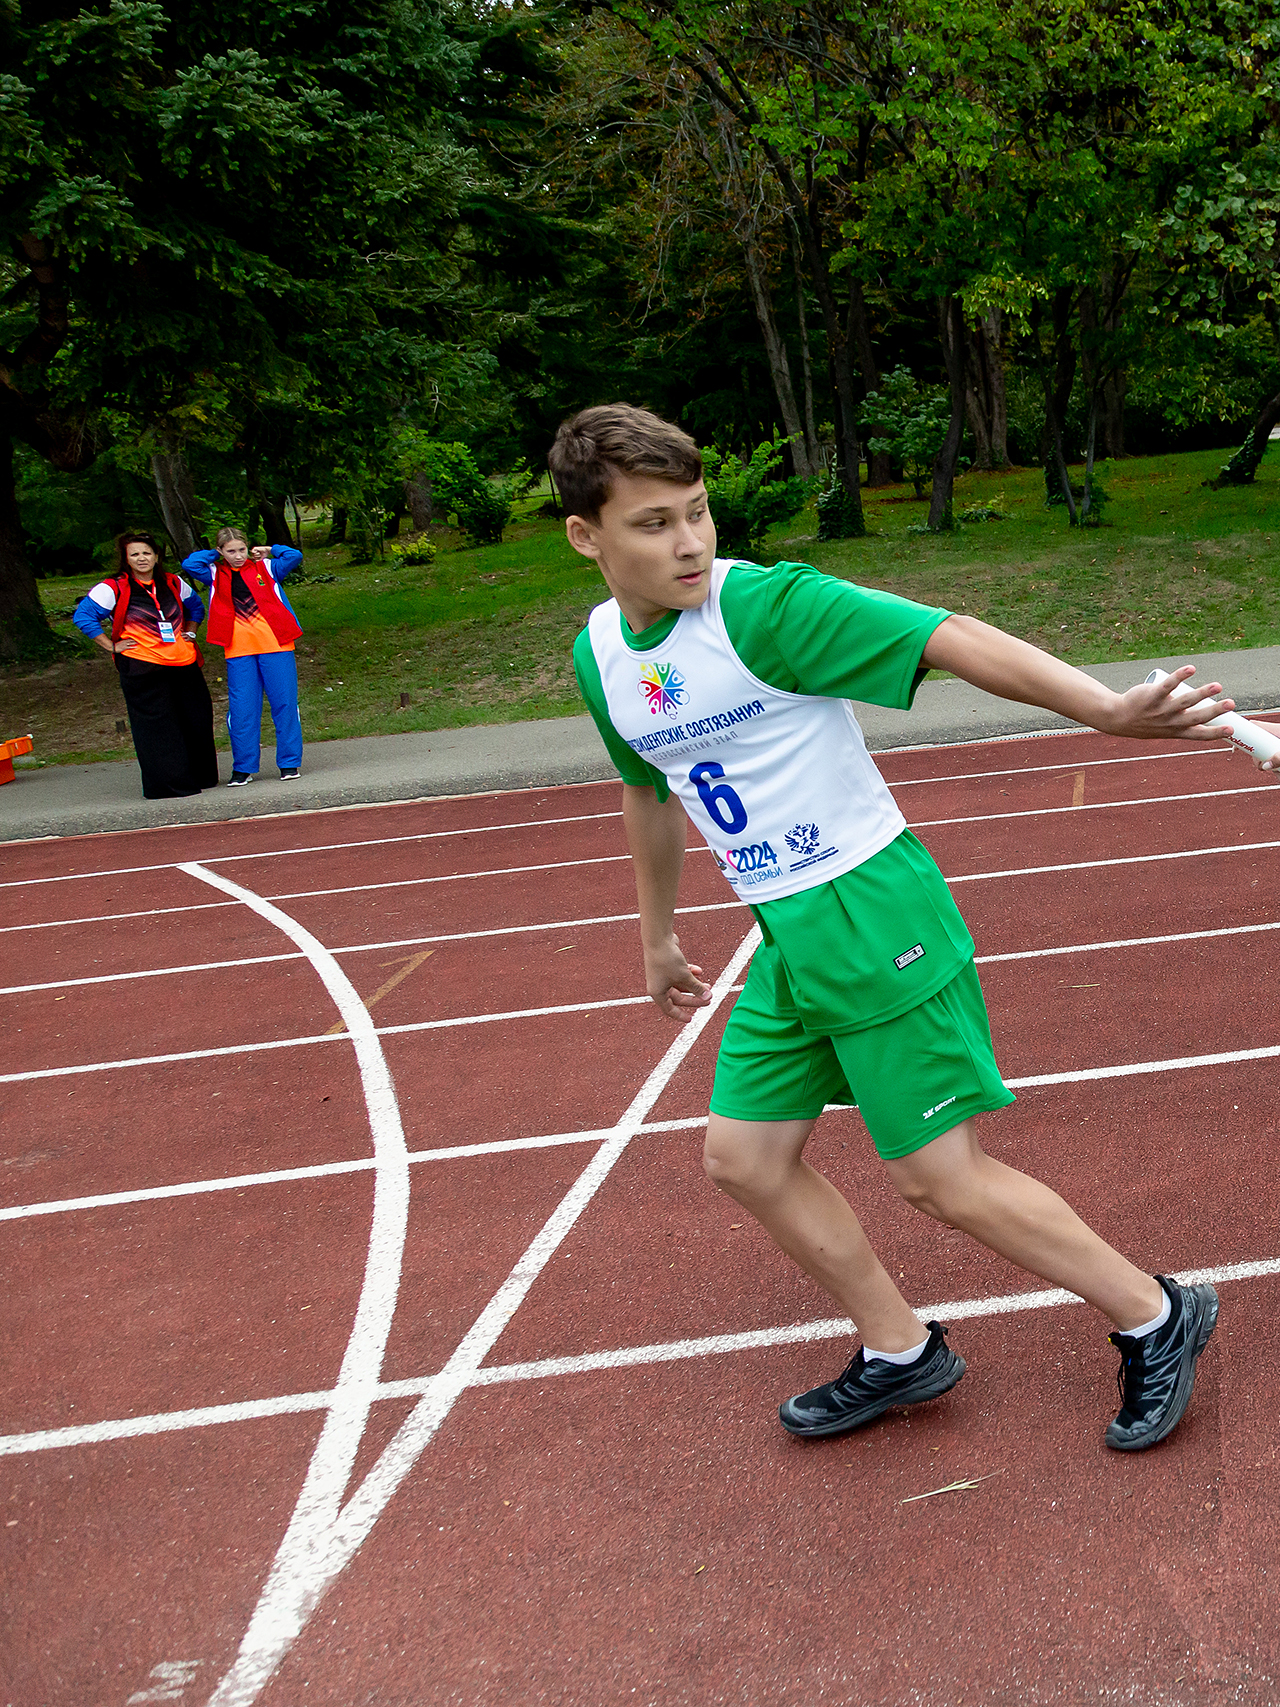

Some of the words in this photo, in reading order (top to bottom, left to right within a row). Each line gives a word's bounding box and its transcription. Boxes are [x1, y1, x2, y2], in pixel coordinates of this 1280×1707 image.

[685, 699, 765, 738] СОСТЯЗАНИЯ
[713, 730, 739, 746] ЭТАП
[689, 761, 748, 835] 6
[731, 840, 778, 873] 2024
[935, 1095, 957, 1112] SPORT
